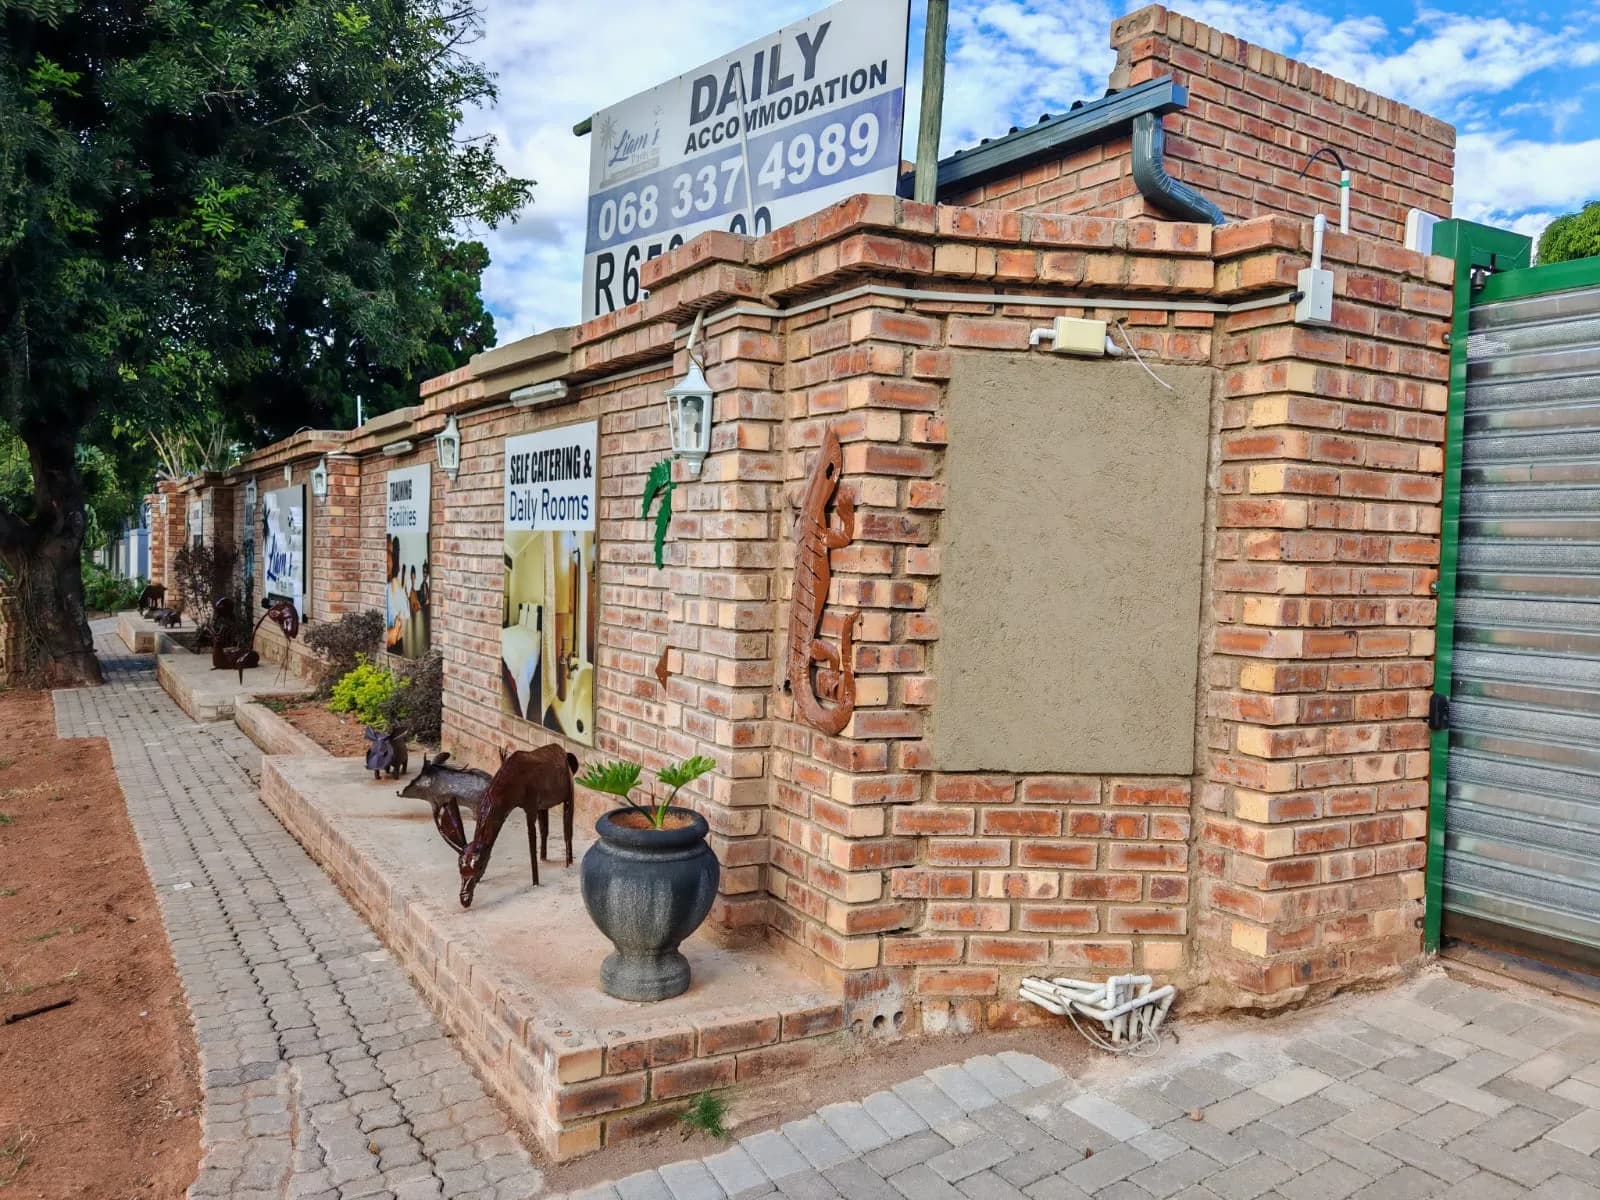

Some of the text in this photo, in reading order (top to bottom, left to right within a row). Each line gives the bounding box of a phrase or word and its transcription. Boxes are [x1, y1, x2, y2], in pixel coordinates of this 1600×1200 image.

[684, 59, 887, 155] ACCOMMODATION
[689, 20, 831, 126] DAILY
[599, 184, 659, 241] 068
[671, 155, 743, 219] 337
[757, 112, 879, 190] 4989
[510, 445, 592, 485] SELF CATERING &
[388, 506, 416, 528] Facilities
[510, 488, 589, 530] Daily Rooms
